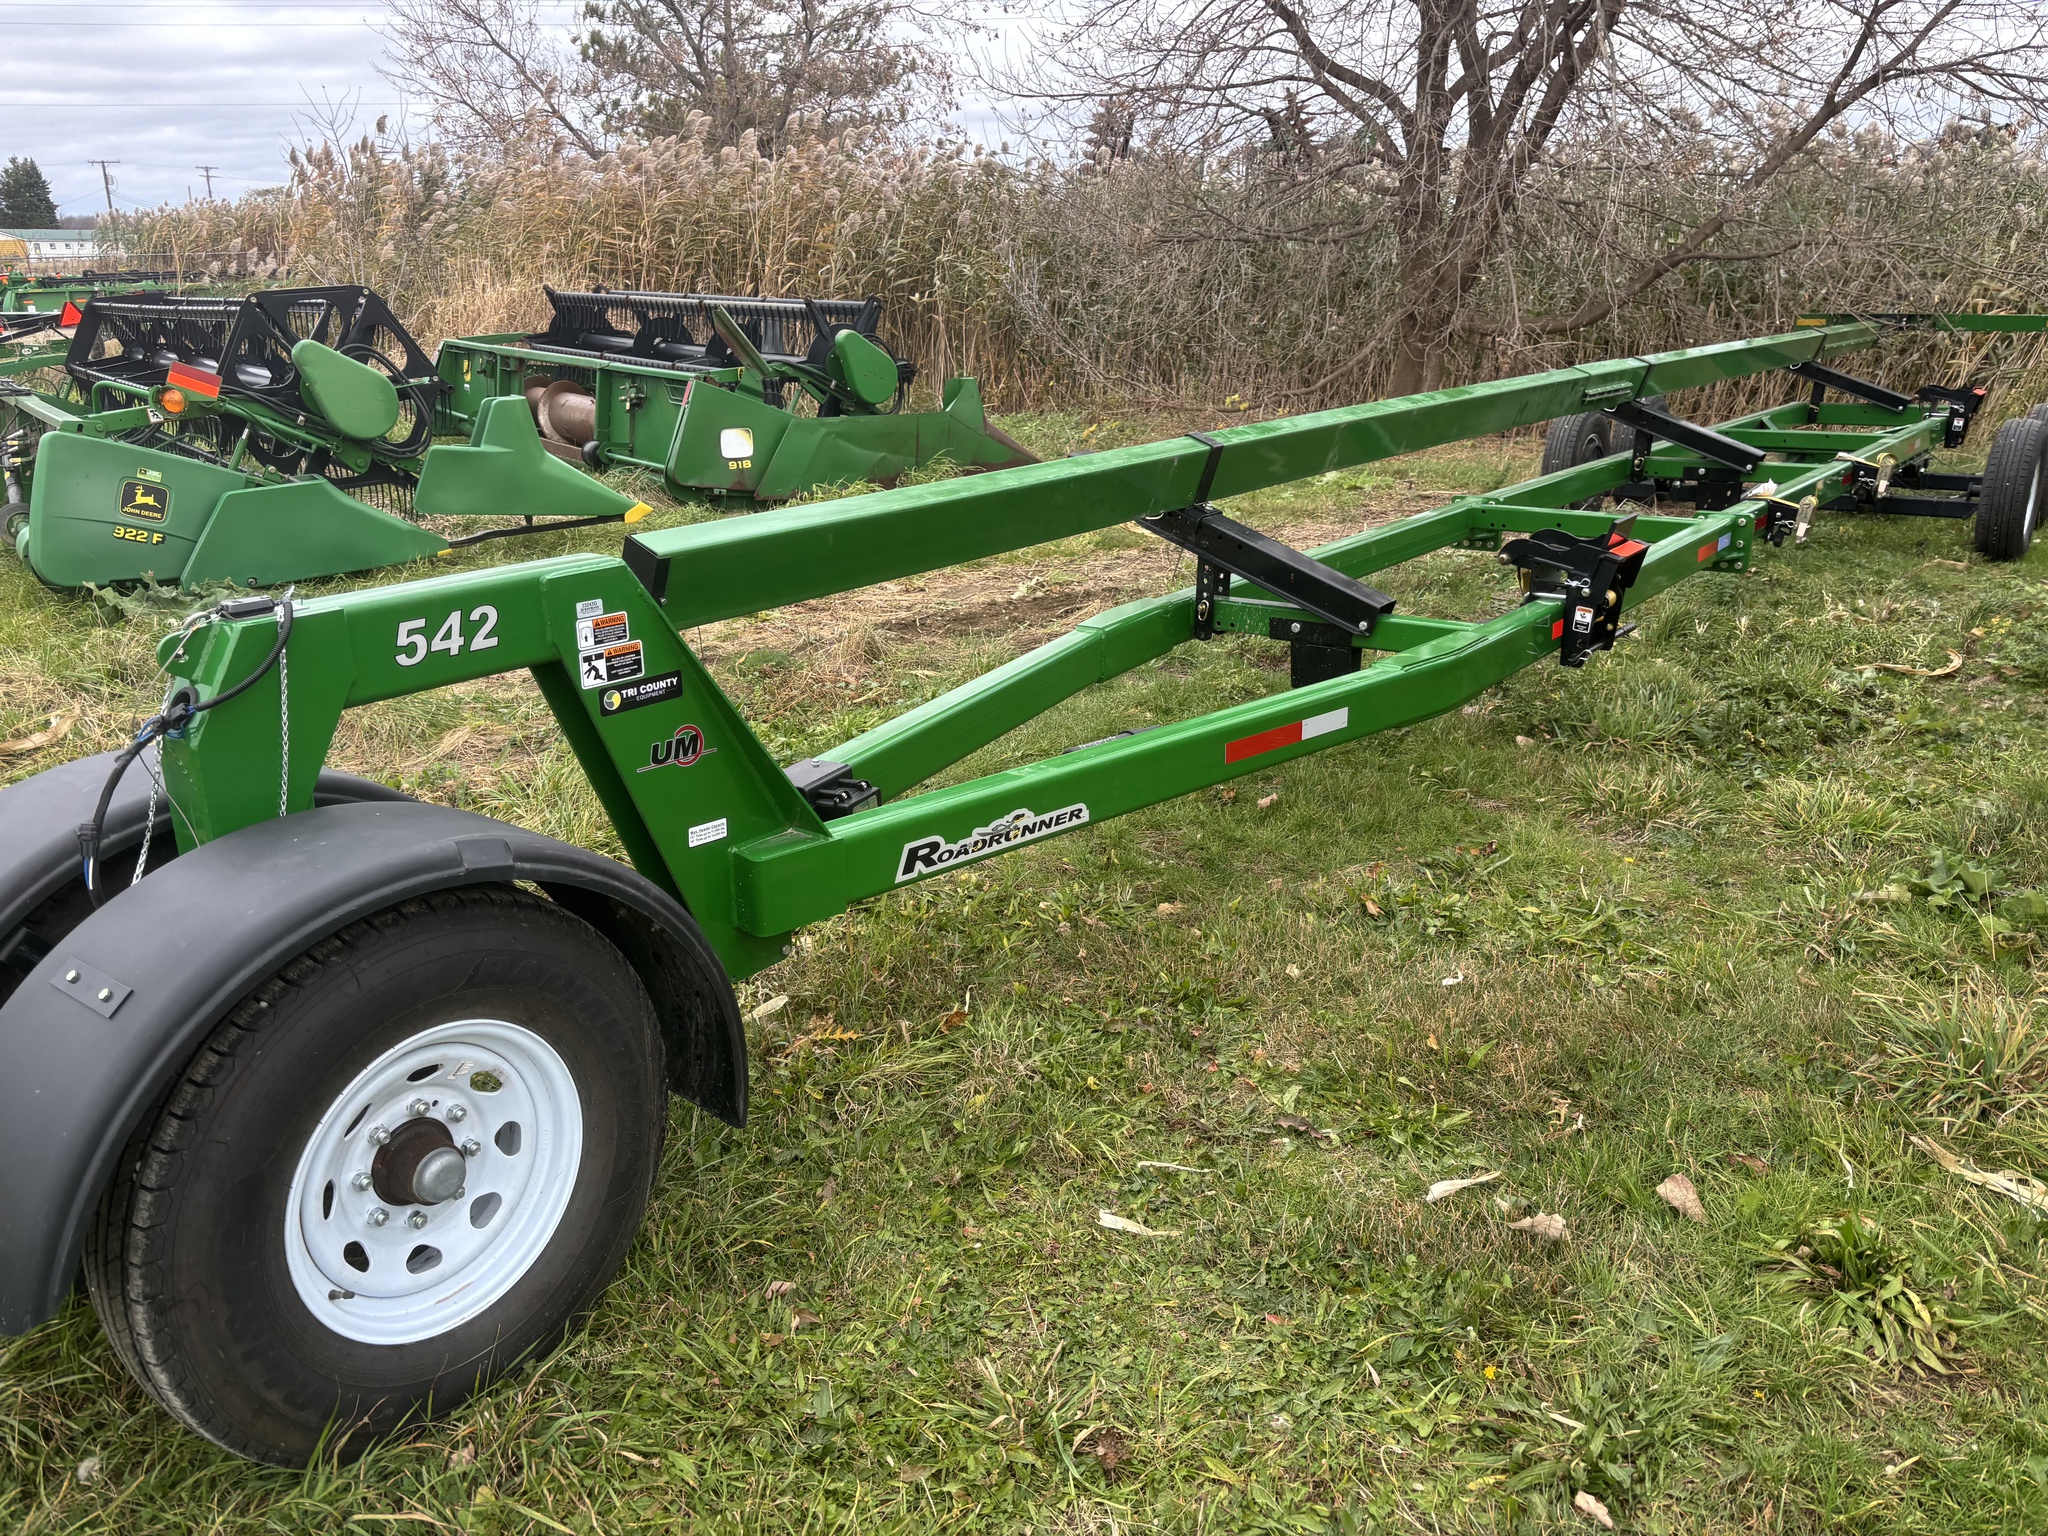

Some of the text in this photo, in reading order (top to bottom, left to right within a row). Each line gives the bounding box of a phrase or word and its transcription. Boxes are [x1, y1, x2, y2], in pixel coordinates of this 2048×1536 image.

[728, 460, 752, 470] 918
[122, 506, 162, 519] JOHN DEERE
[112, 526, 164, 544] 922 F
[600, 616, 625, 625] WARNING
[394, 604, 499, 667] 542
[613, 643, 639, 654] WARNING
[621, 677, 678, 698] TRI COUNTY
[636, 689, 666, 701] EQUIPMENT
[650, 733, 699, 765] UM
[902, 808, 1083, 876] ROADRUNNER
